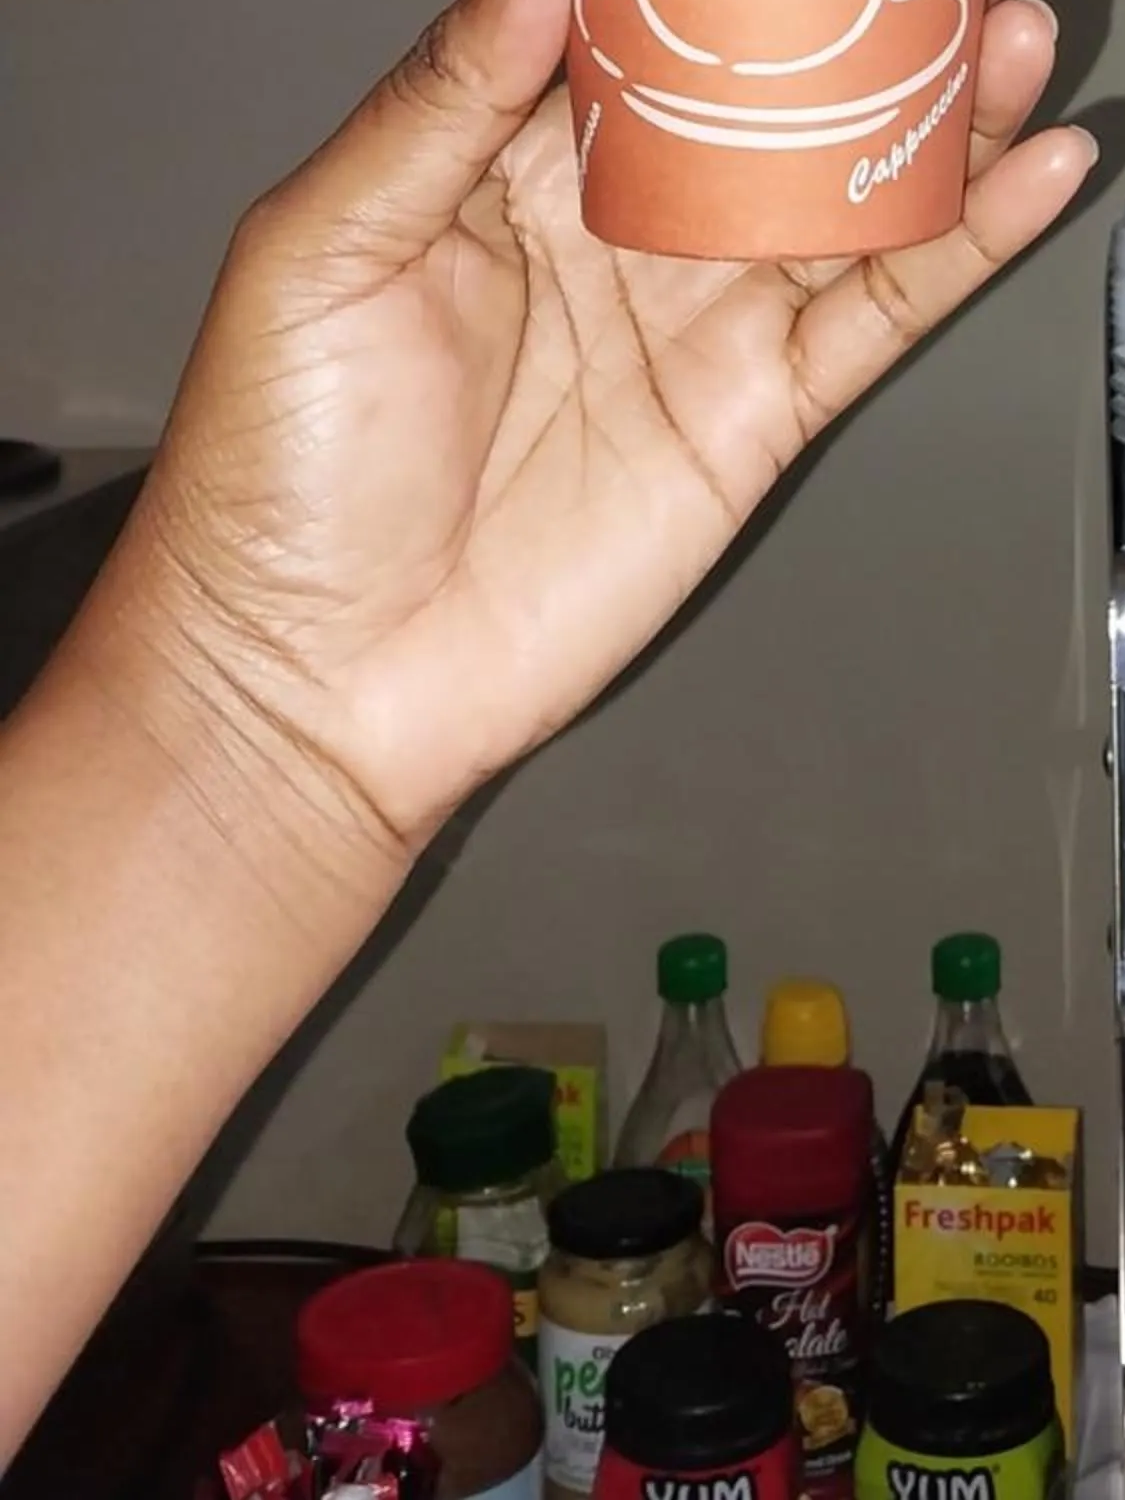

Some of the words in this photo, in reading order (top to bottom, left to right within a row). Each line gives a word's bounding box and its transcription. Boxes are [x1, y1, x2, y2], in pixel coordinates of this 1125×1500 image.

[904, 1201, 1056, 1242] Freshpak
[973, 1252, 1058, 1269] ROOIBOS
[891, 1467, 990, 1500] YUM
